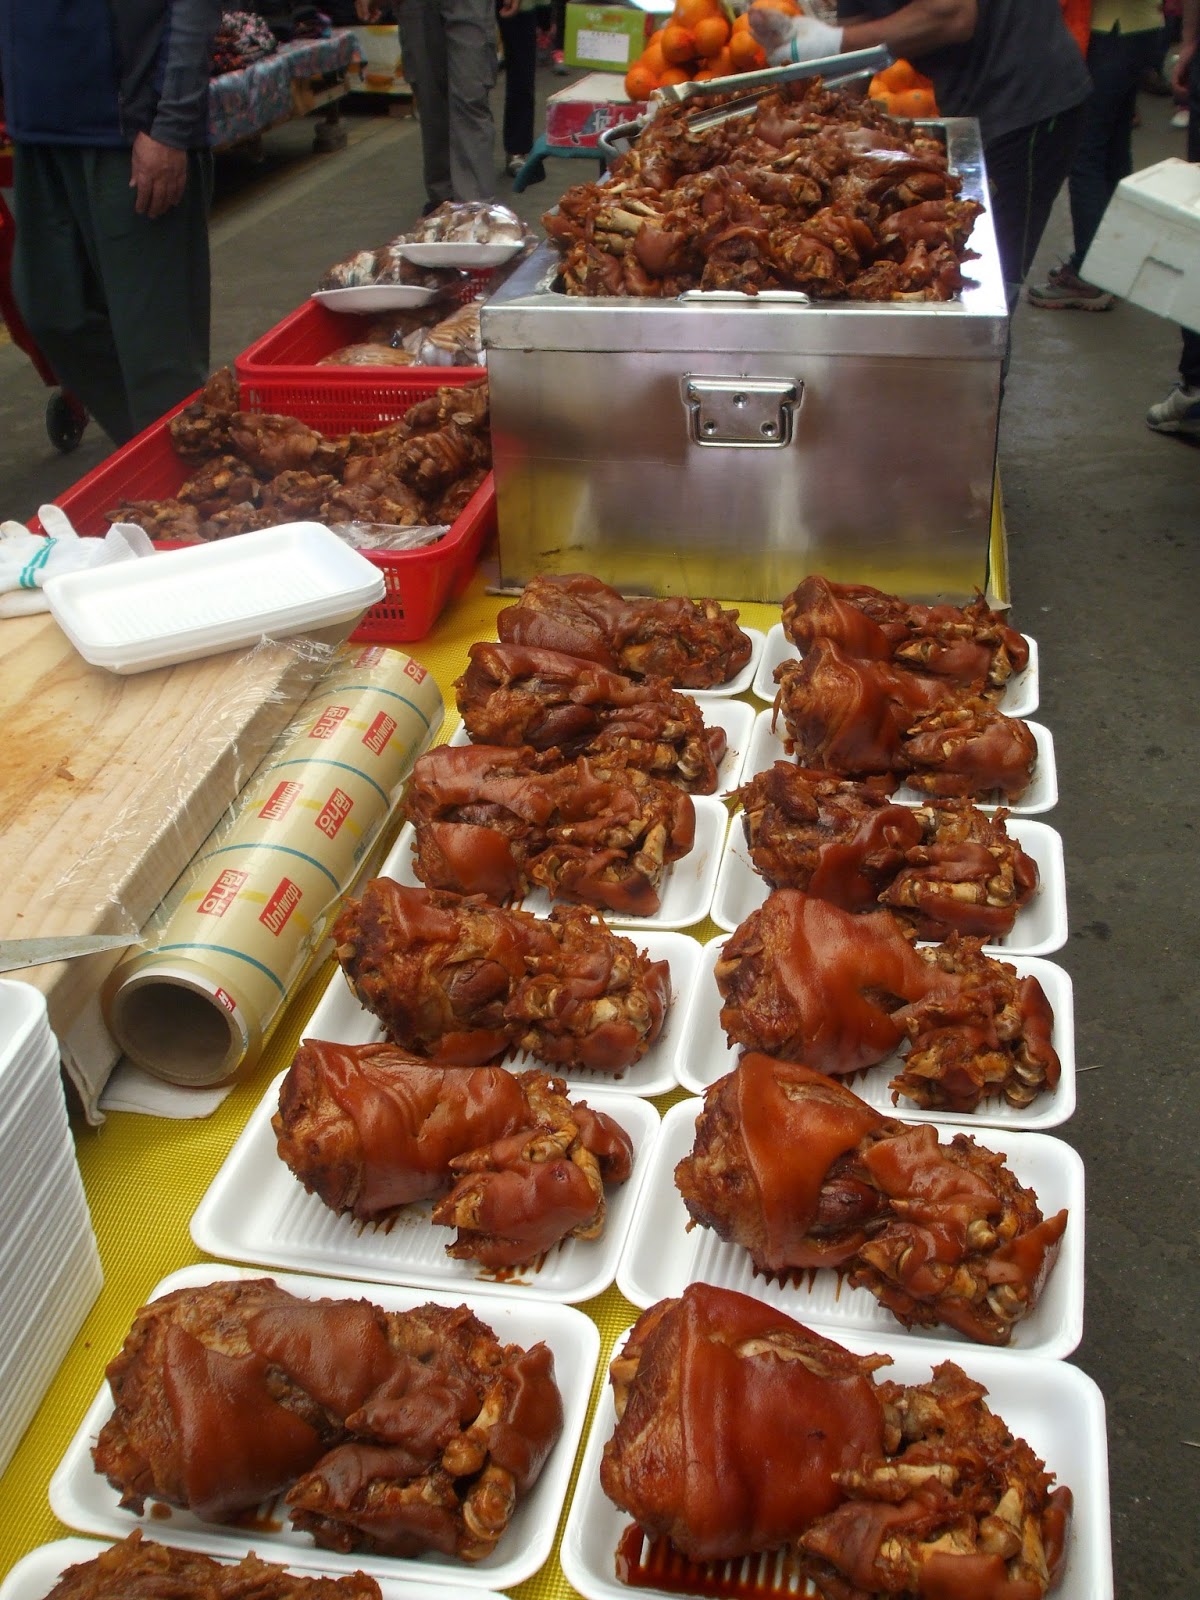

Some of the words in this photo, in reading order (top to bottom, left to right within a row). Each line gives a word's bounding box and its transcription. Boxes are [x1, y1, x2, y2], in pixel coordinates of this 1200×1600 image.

[312, 706, 347, 739] 유니랩
[365, 715, 395, 753] Uniwrap
[261, 781, 303, 820] Uniwrap
[319, 790, 351, 836] 유니랩
[202, 870, 246, 915] 유니랩
[263, 882, 300, 933] Uniwrap
